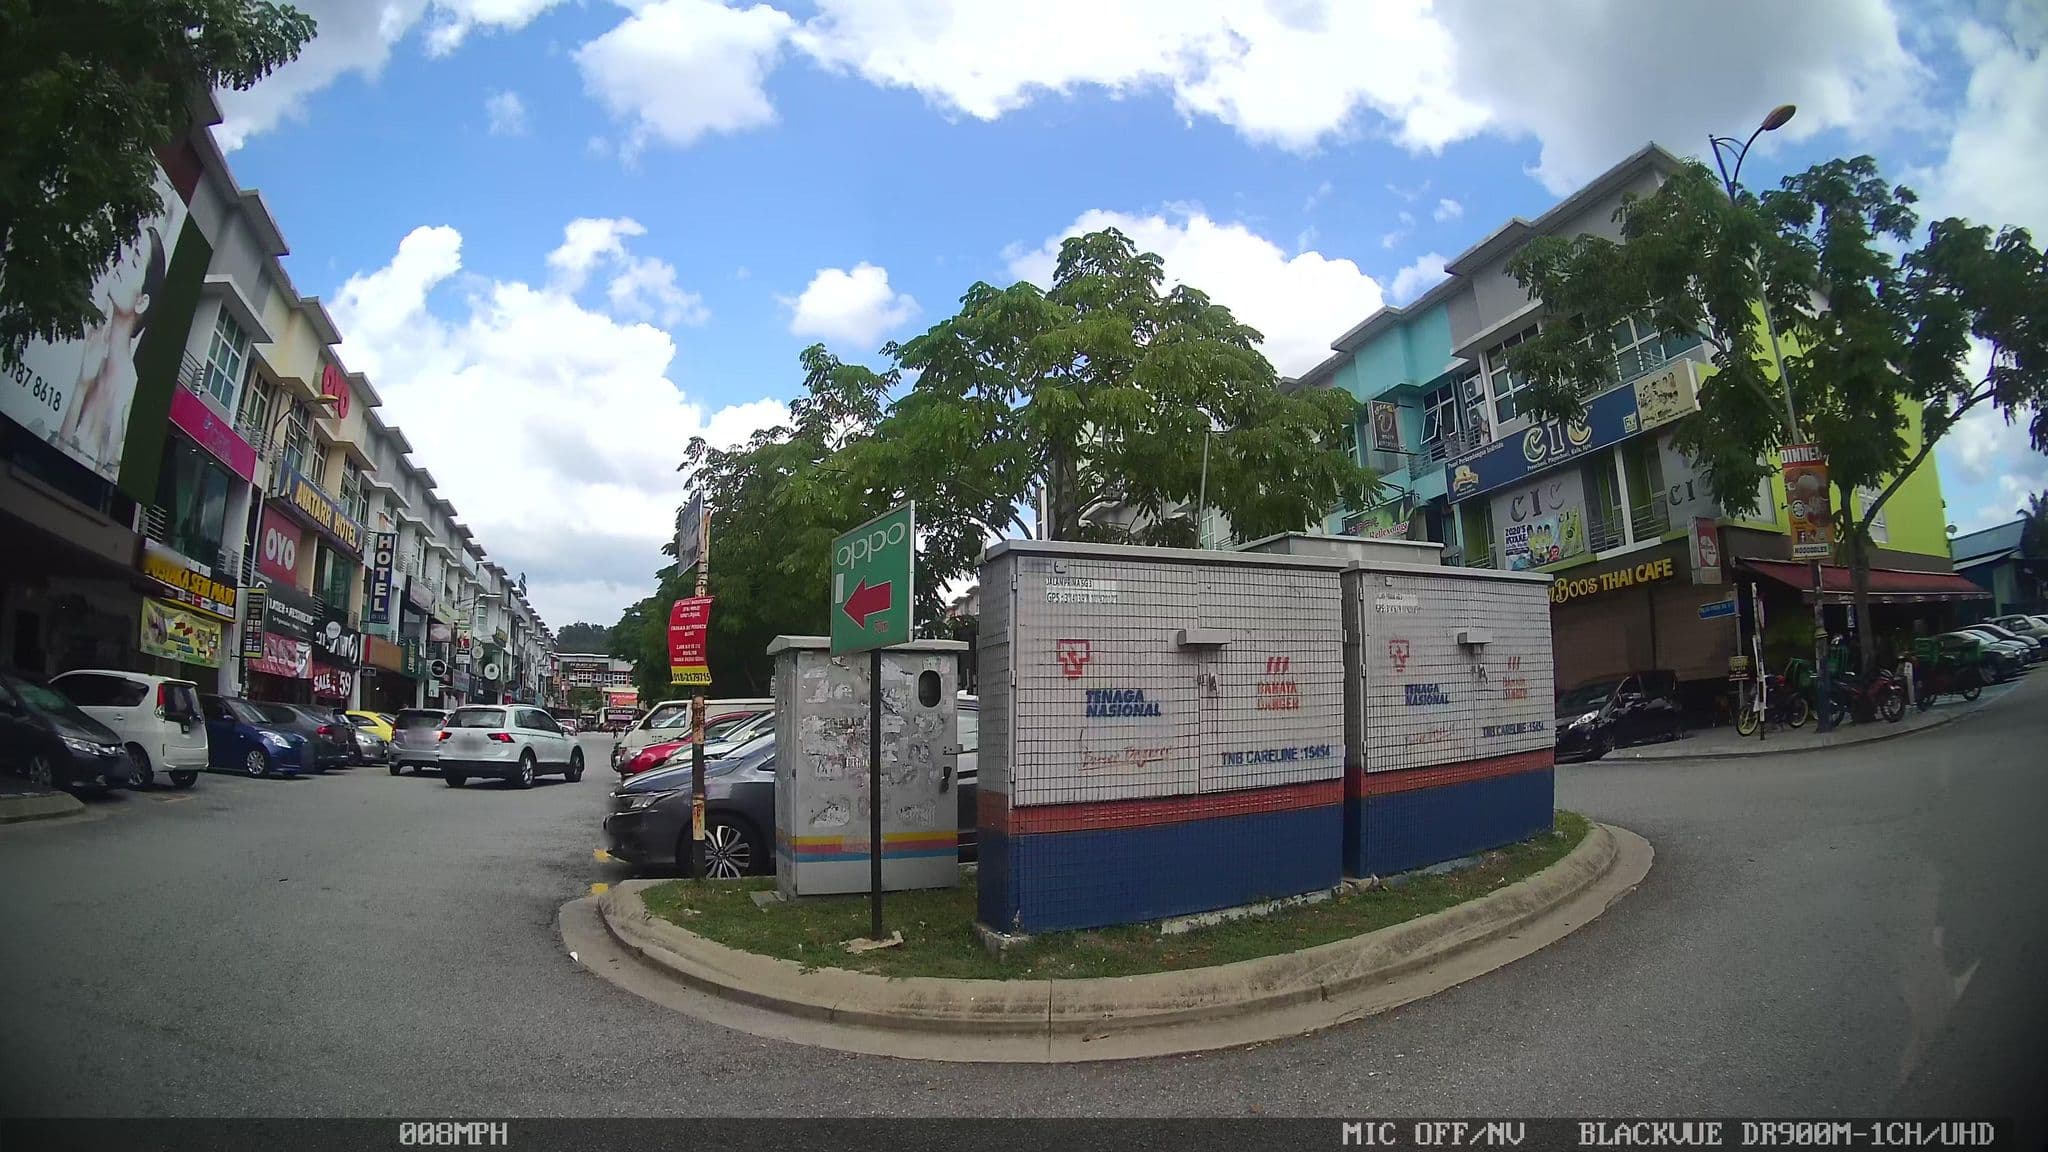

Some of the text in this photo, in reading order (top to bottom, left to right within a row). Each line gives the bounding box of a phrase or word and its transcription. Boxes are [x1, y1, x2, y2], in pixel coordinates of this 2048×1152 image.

[33, 376, 62, 412] 8618
[334, 512, 357, 548] HOTEL
[836, 522, 906, 570] oppo
[265, 527, 295, 571] OYO
[373, 535, 393, 612] HOTEL
[1600, 567, 1634, 591] THAI
[1636, 558, 1673, 582] CAFE
[313, 671, 352, 697] SALE 59
[1086, 689, 1144, 703] TENAGA
[1405, 694, 1450, 706] NASIONAL
[1086, 702, 1161, 718] NASIONAL
[1222, 752, 1243, 765] TNB
[1245, 748, 1298, 764] CARELINE
